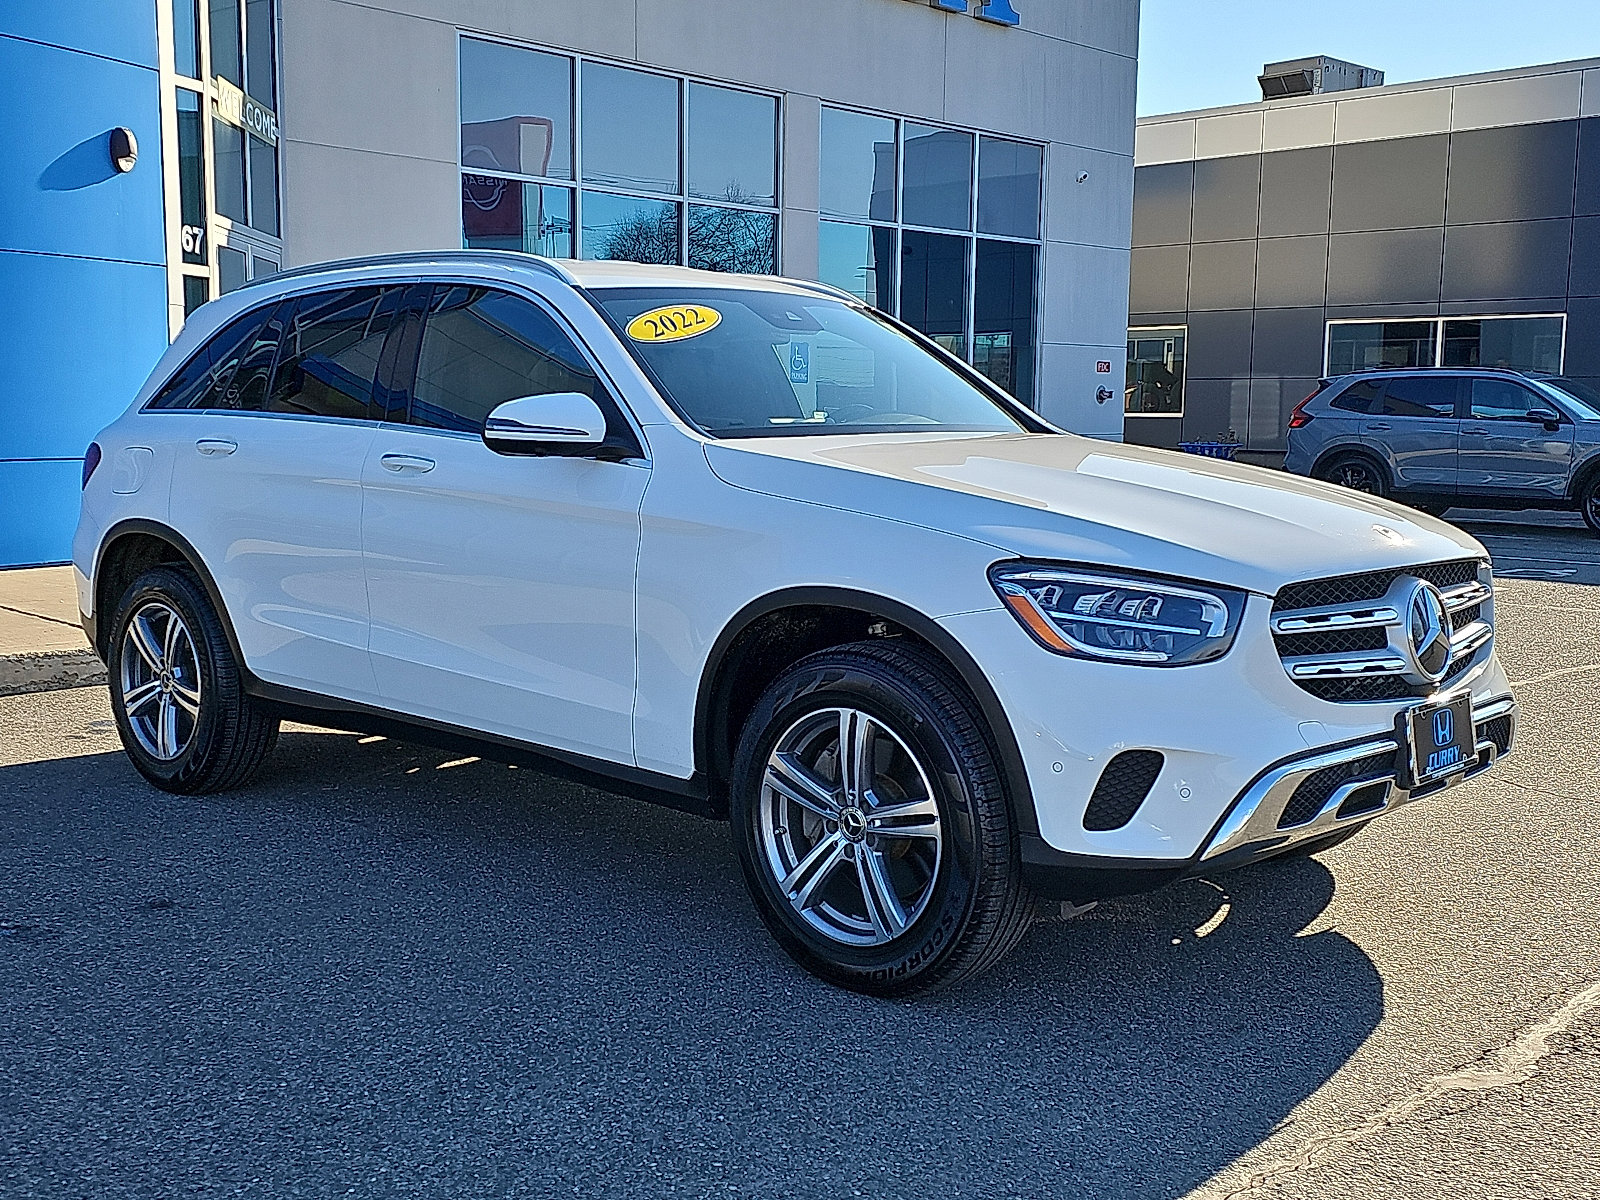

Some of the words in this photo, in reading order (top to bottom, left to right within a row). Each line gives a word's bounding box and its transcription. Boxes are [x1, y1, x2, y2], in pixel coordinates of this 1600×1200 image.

[218, 85, 276, 141] WELCOME
[181, 225, 205, 255] 67
[644, 308, 705, 337] 2022
[1098, 362, 1110, 372] FDC
[1428, 745, 1461, 770] CURRY
[855, 909, 954, 982] SCORPION
